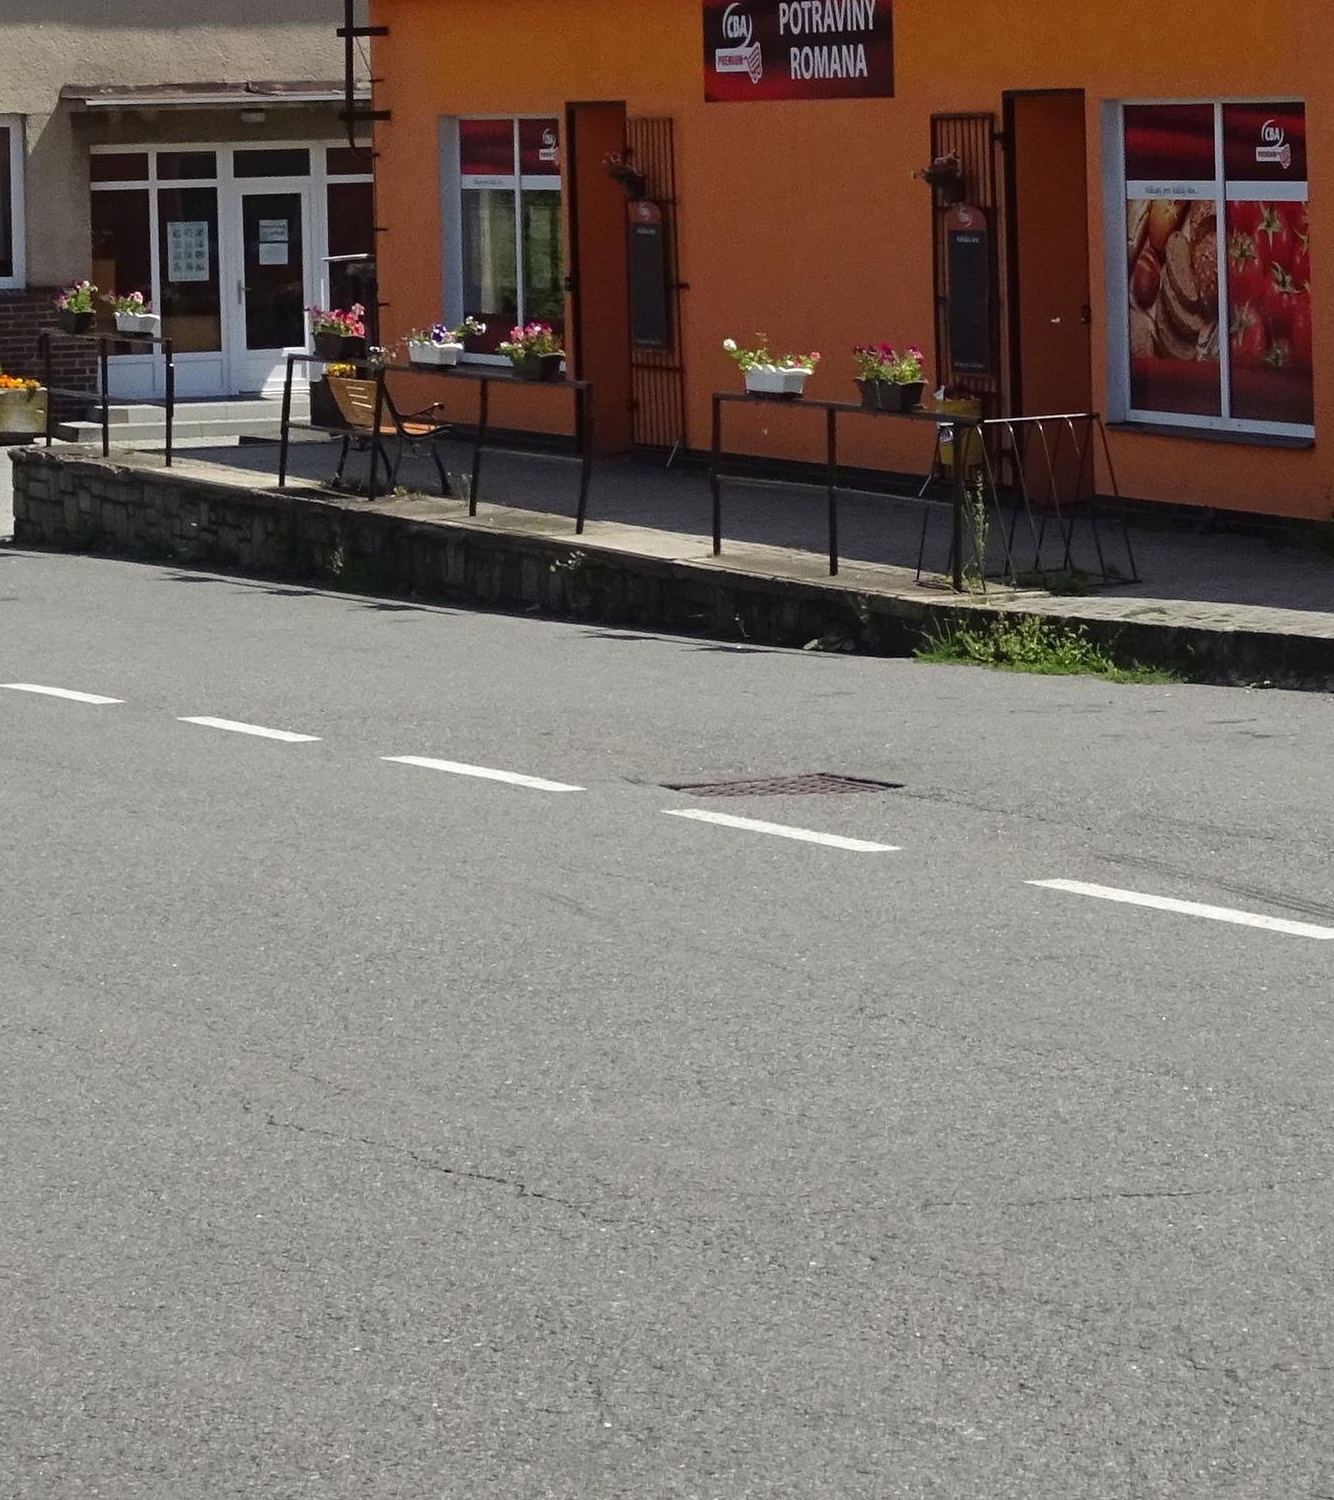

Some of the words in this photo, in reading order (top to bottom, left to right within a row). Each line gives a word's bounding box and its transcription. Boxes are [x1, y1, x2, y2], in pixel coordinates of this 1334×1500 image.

[727, 15, 747, 38] CBA
[790, 44, 867, 79] ROMANA
[1265, 127, 1280, 141] CBA
